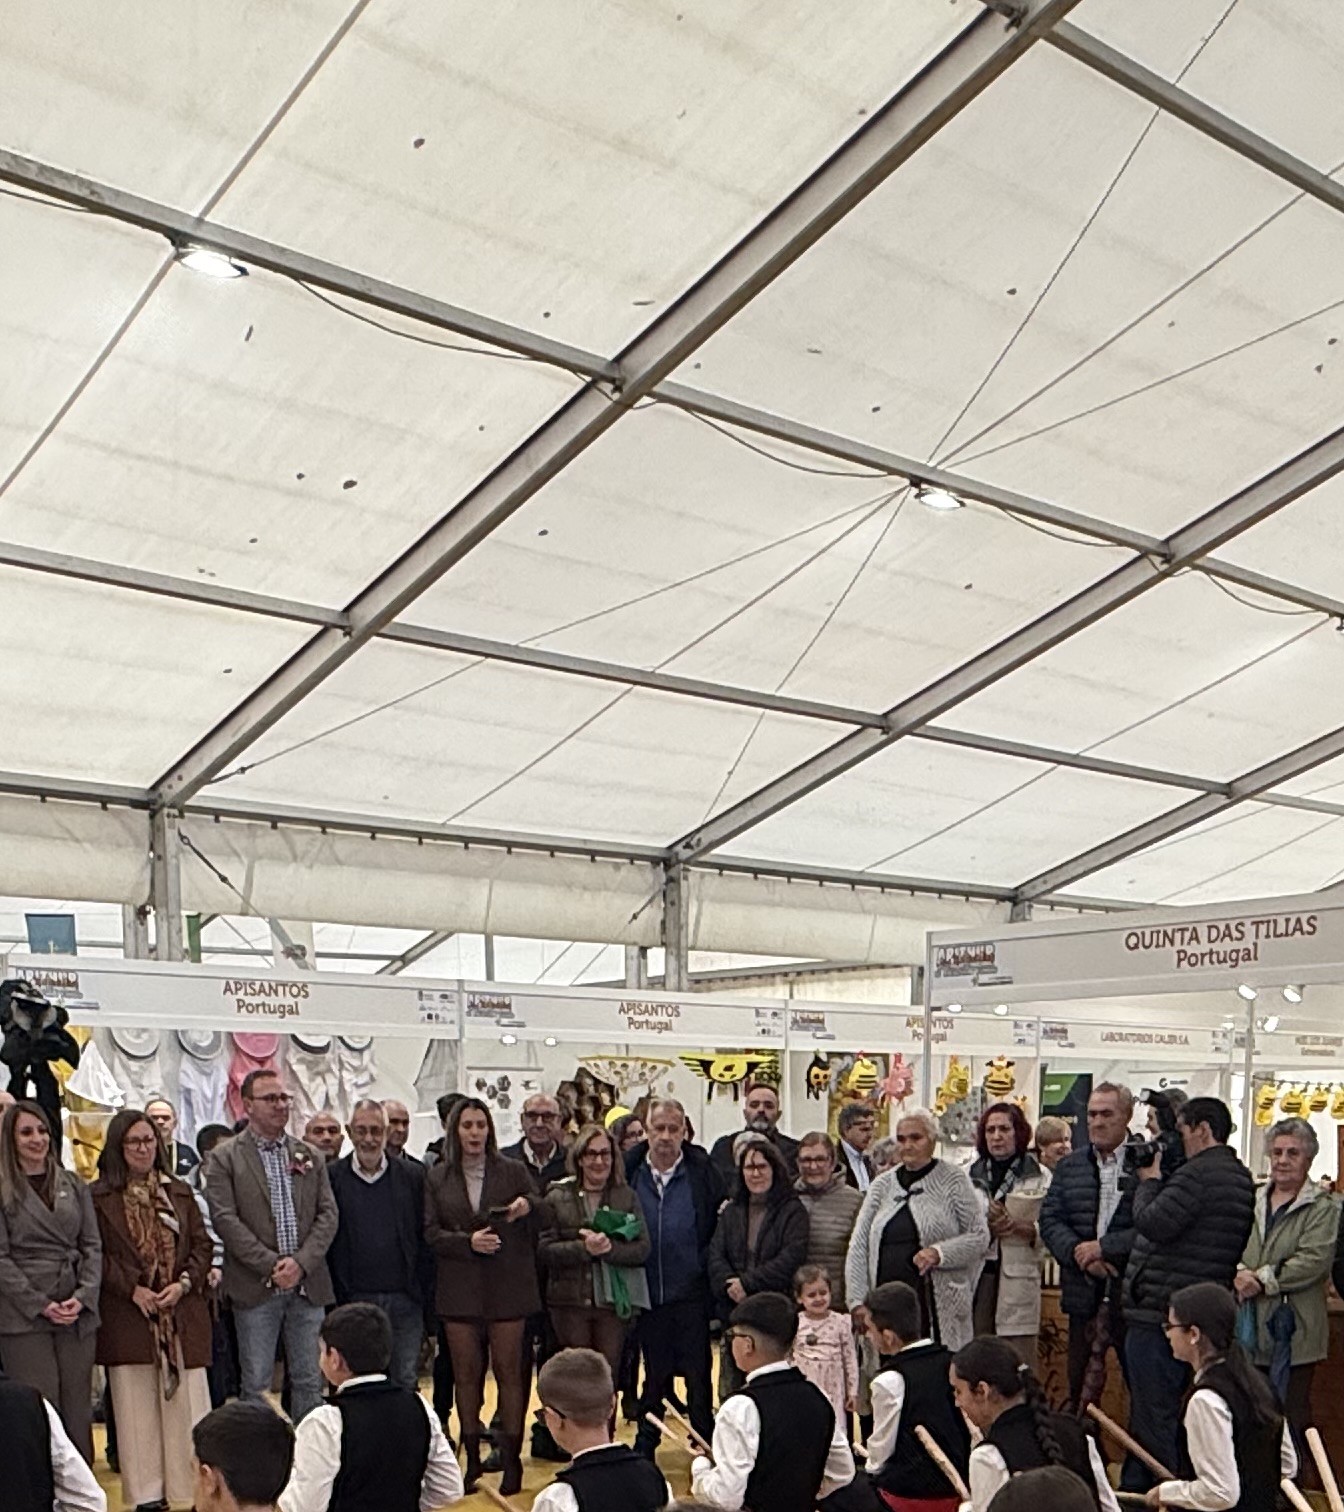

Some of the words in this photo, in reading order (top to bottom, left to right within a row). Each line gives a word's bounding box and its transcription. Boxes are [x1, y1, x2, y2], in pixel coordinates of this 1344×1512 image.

[1124, 926, 1201, 951] QUINTA
[1207, 921, 1246, 944] DAS
[1250, 915, 1318, 940] TILIAS
[1175, 941, 1258, 970] Portugal
[222, 980, 310, 999] APISANTOS
[235, 998, 300, 1019] Portugal
[618, 1002, 681, 1018] APISANTOS
[627, 1016, 673, 1034] Portugal
[905, 1017, 954, 1030] APISNTOS
